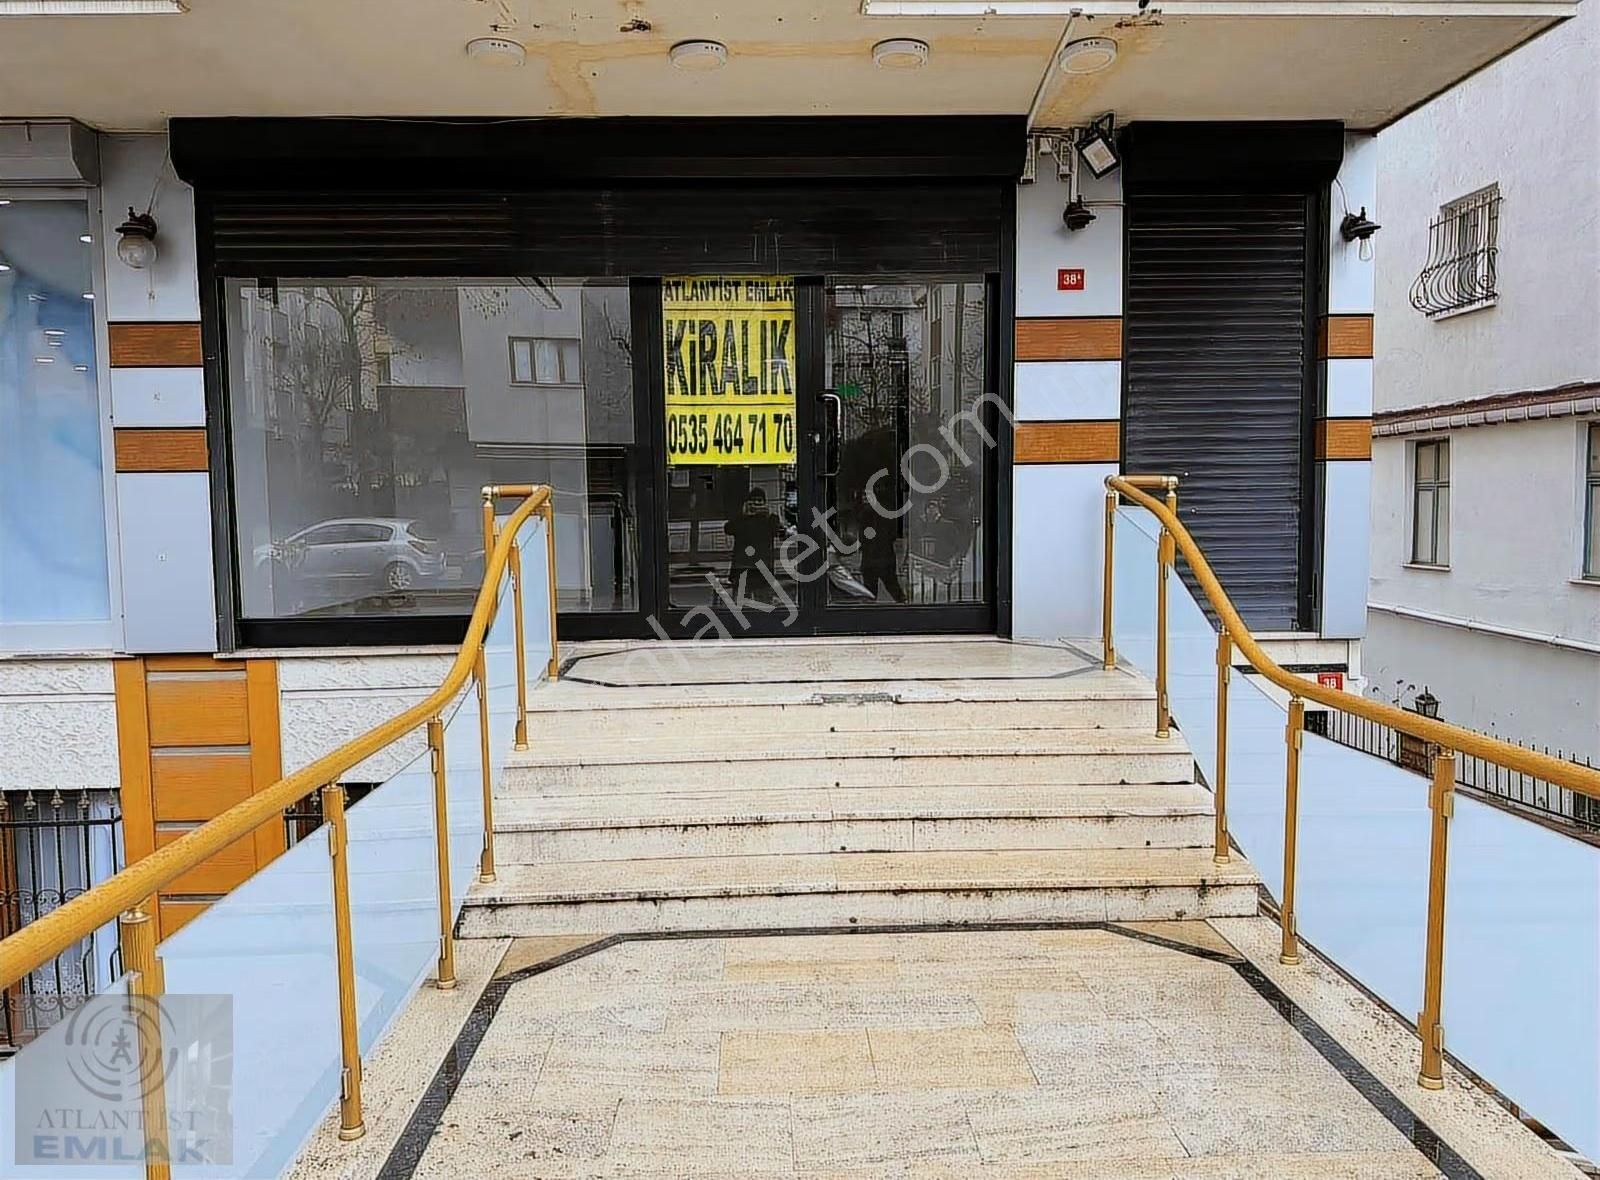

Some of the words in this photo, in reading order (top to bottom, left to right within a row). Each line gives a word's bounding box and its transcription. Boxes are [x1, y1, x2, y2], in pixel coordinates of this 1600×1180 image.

[745, 280, 793, 302] EMLAK
[668, 414, 708, 454] 0535
[713, 414, 744, 453] 464
[749, 415, 767, 453] 71
[773, 414, 793, 453] 70
